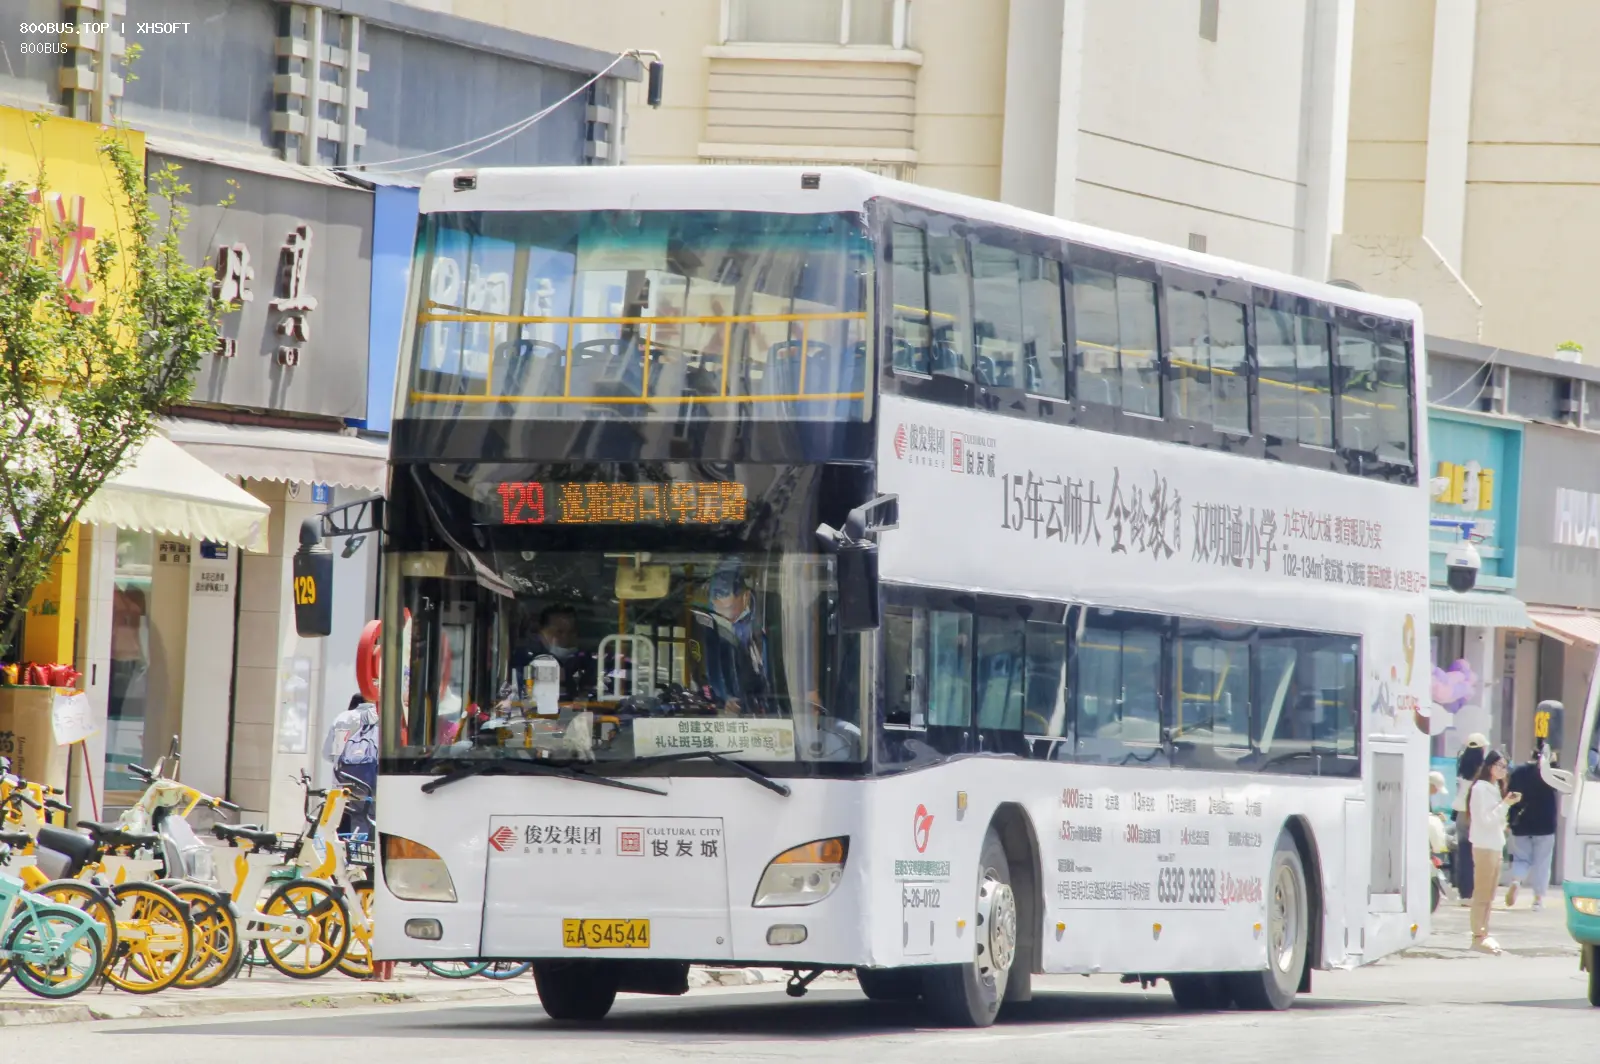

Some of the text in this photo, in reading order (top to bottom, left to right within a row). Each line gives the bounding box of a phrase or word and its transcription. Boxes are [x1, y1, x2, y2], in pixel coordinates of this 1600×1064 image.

[497, 481, 545, 524] 129
[1191, 501, 1277, 573] 双明通小学
[294, 575, 316, 605] 129
[678, 720, 749, 734] 创建文明城市
[524, 825, 602, 845] 俊发集团
[646, 827, 721, 836] CULTURAL CITY
[651, 839, 718, 858] 俊发城
[1158, 867, 1186, 904] 6339
[1188, 867, 1216, 904] 3388
